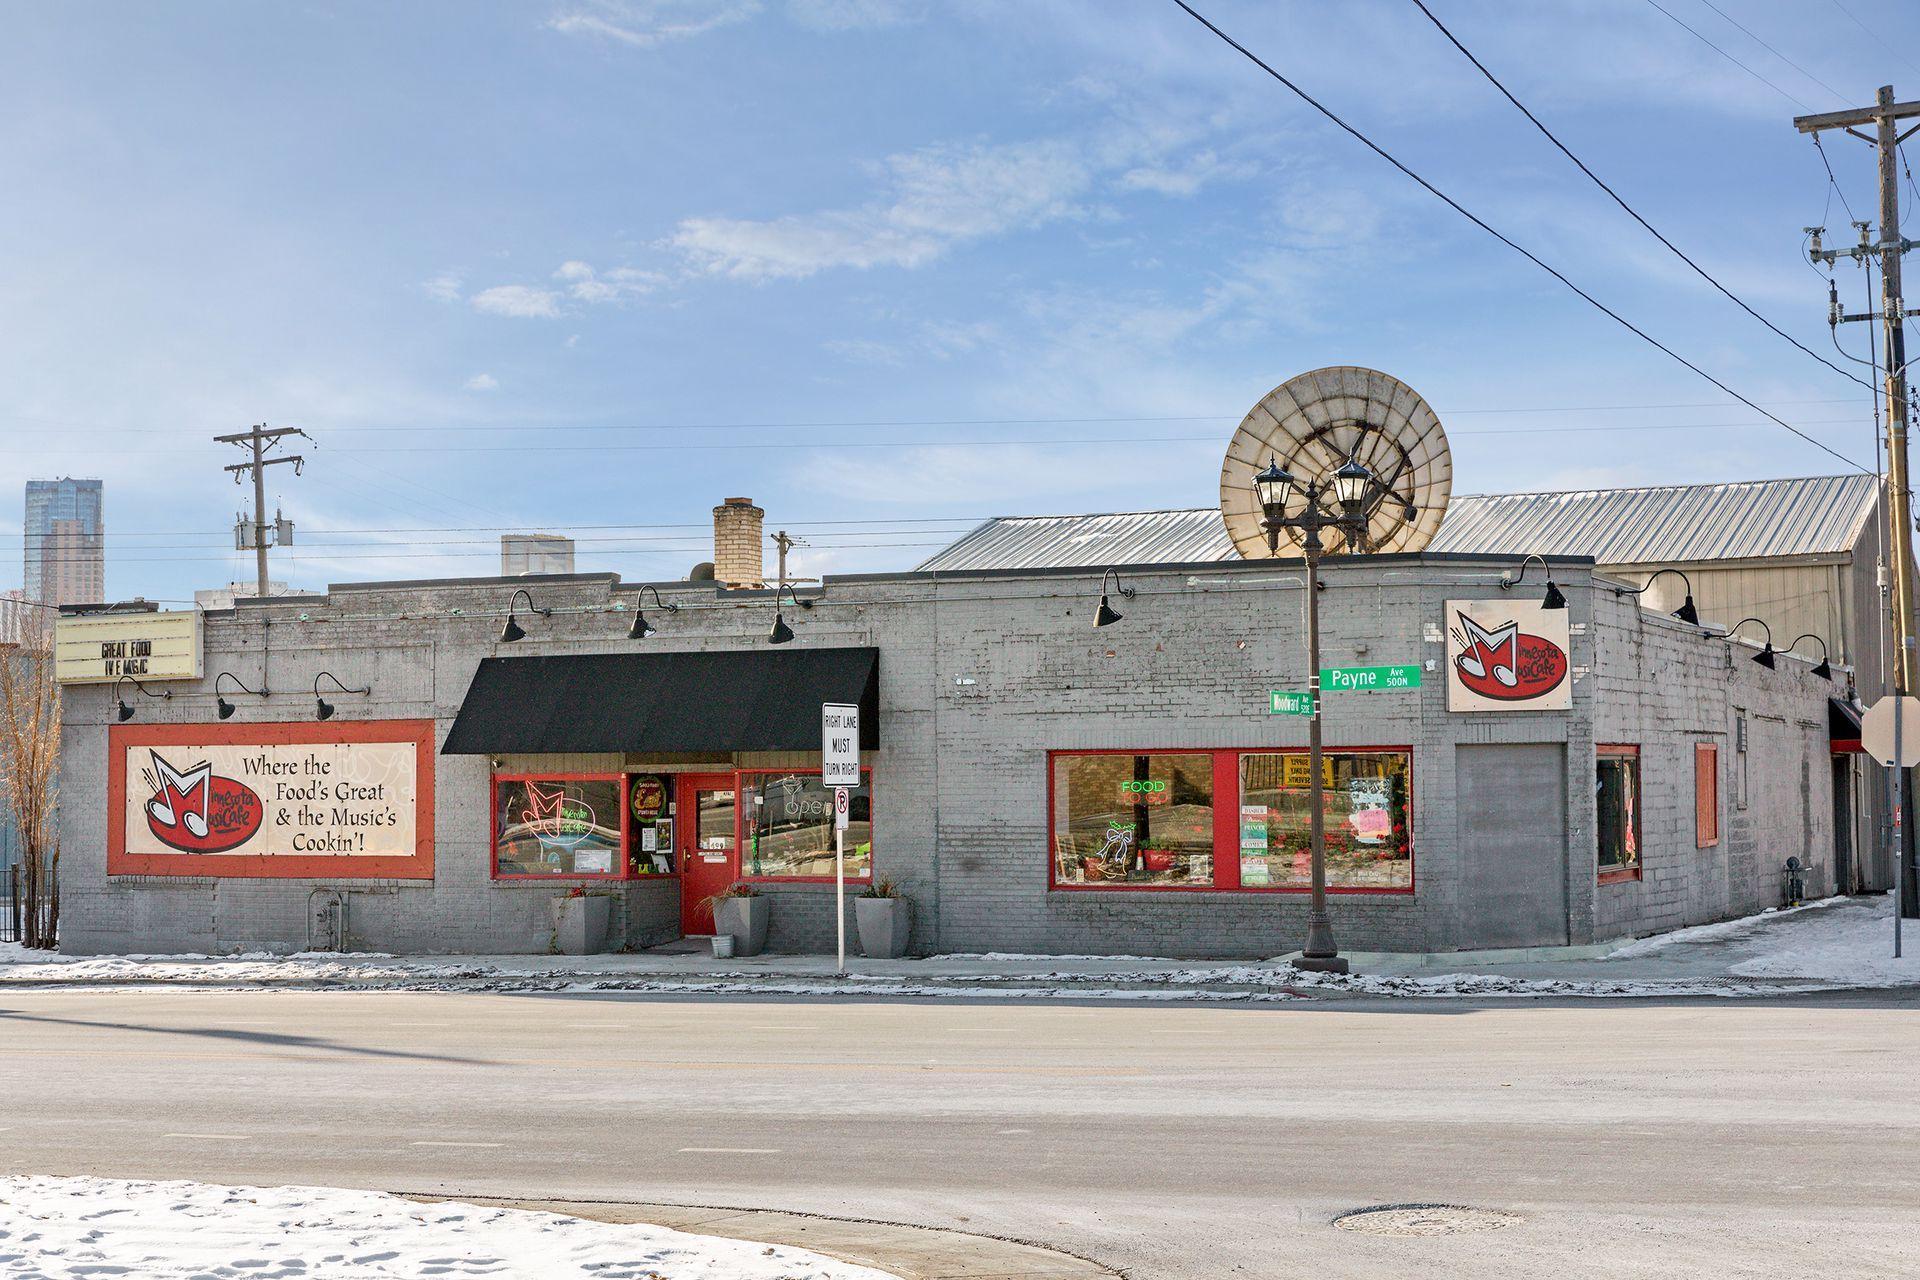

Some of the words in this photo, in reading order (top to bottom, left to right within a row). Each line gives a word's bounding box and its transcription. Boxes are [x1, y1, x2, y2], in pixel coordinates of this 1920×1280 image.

[101, 642, 126, 658] GREAT
[131, 641, 151, 657] FOOD
[1332, 670, 1377, 689] Payne
[1390, 668, 1404, 676] Ave
[1386, 678, 1408, 686] 500N
[1273, 694, 1299, 711] Woodward
[825, 715, 841, 728] RIGHT
[843, 716, 857, 728] LANE
[832, 738, 850, 753] MUST
[242, 754, 298, 775] Where
[304, 754, 331, 775] the
[826, 763, 840, 775] TURN
[841, 763, 858, 775] RIGHT
[276, 780, 329, 800] Food's
[335, 782, 384, 800] Great
[1122, 781, 1165, 792] FOOD
[1145, 792, 1168, 803] GO
[276, 808, 290, 826] &
[298, 805, 324, 826] the
[331, 806, 397, 826] Music's
[292, 831, 364, 851] Cookin'!
